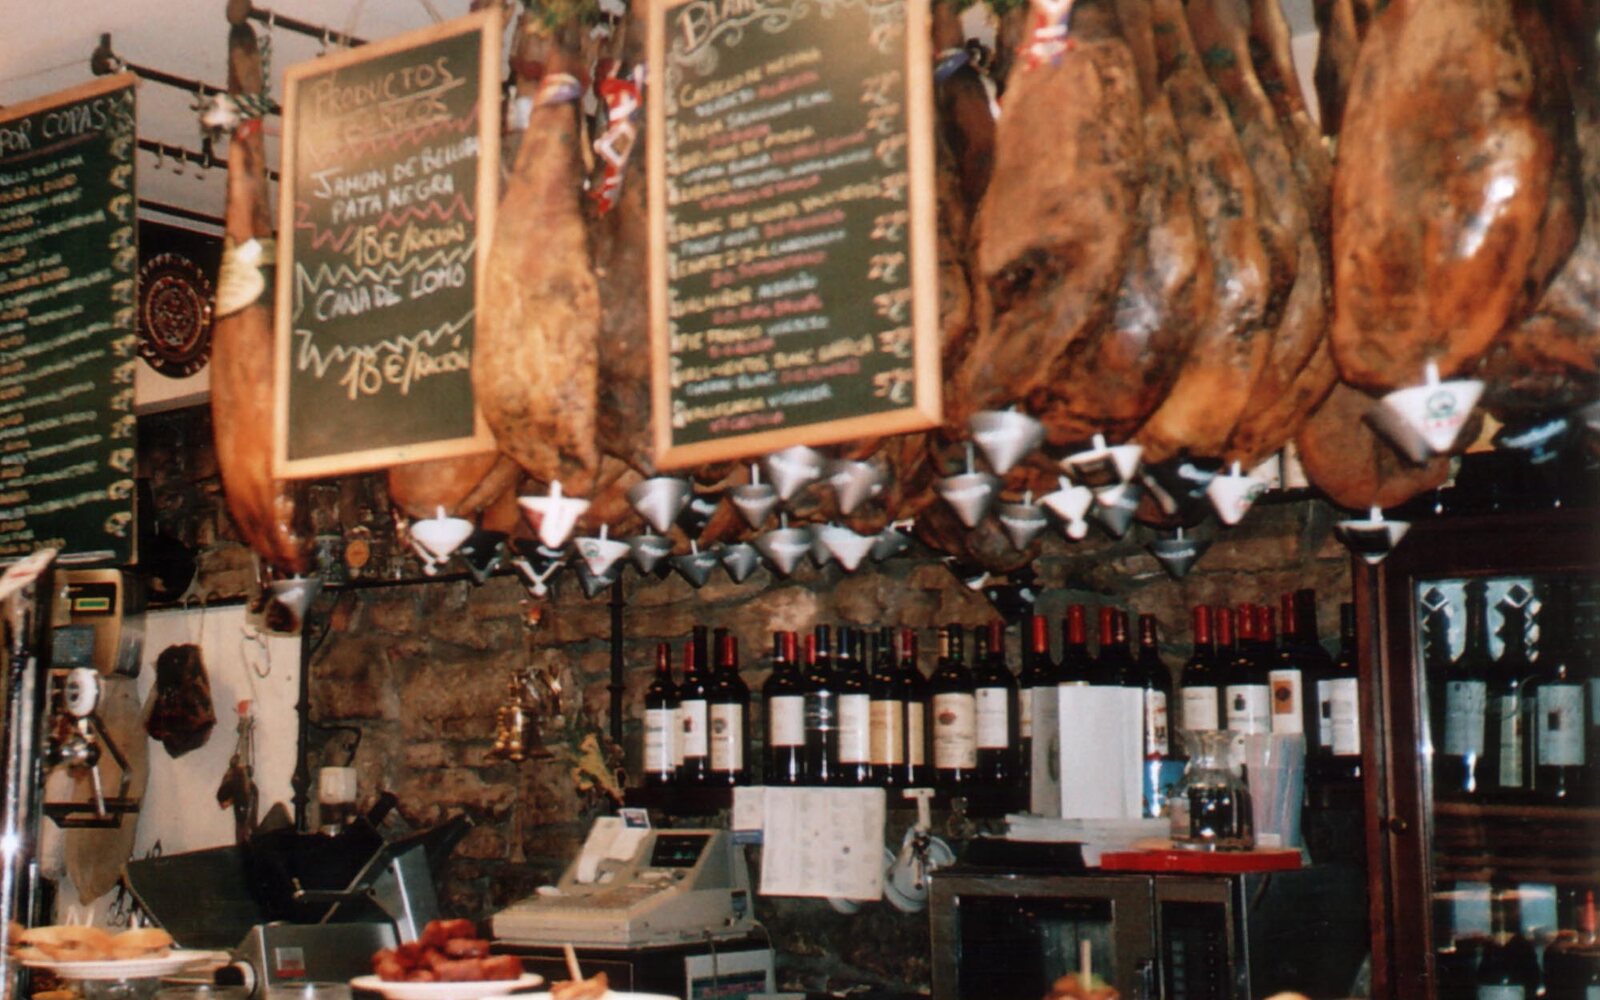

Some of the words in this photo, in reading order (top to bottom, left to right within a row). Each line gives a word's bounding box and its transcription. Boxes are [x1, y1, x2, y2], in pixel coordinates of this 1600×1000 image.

[311, 56, 455, 119] PRODUCTOS
[42, 98, 107, 139] COPAS
[392, 159, 418, 183] DE
[331, 197, 383, 226] PATA
[387, 173, 455, 212] NEGRA
[410, 262, 466, 300] LOMO
